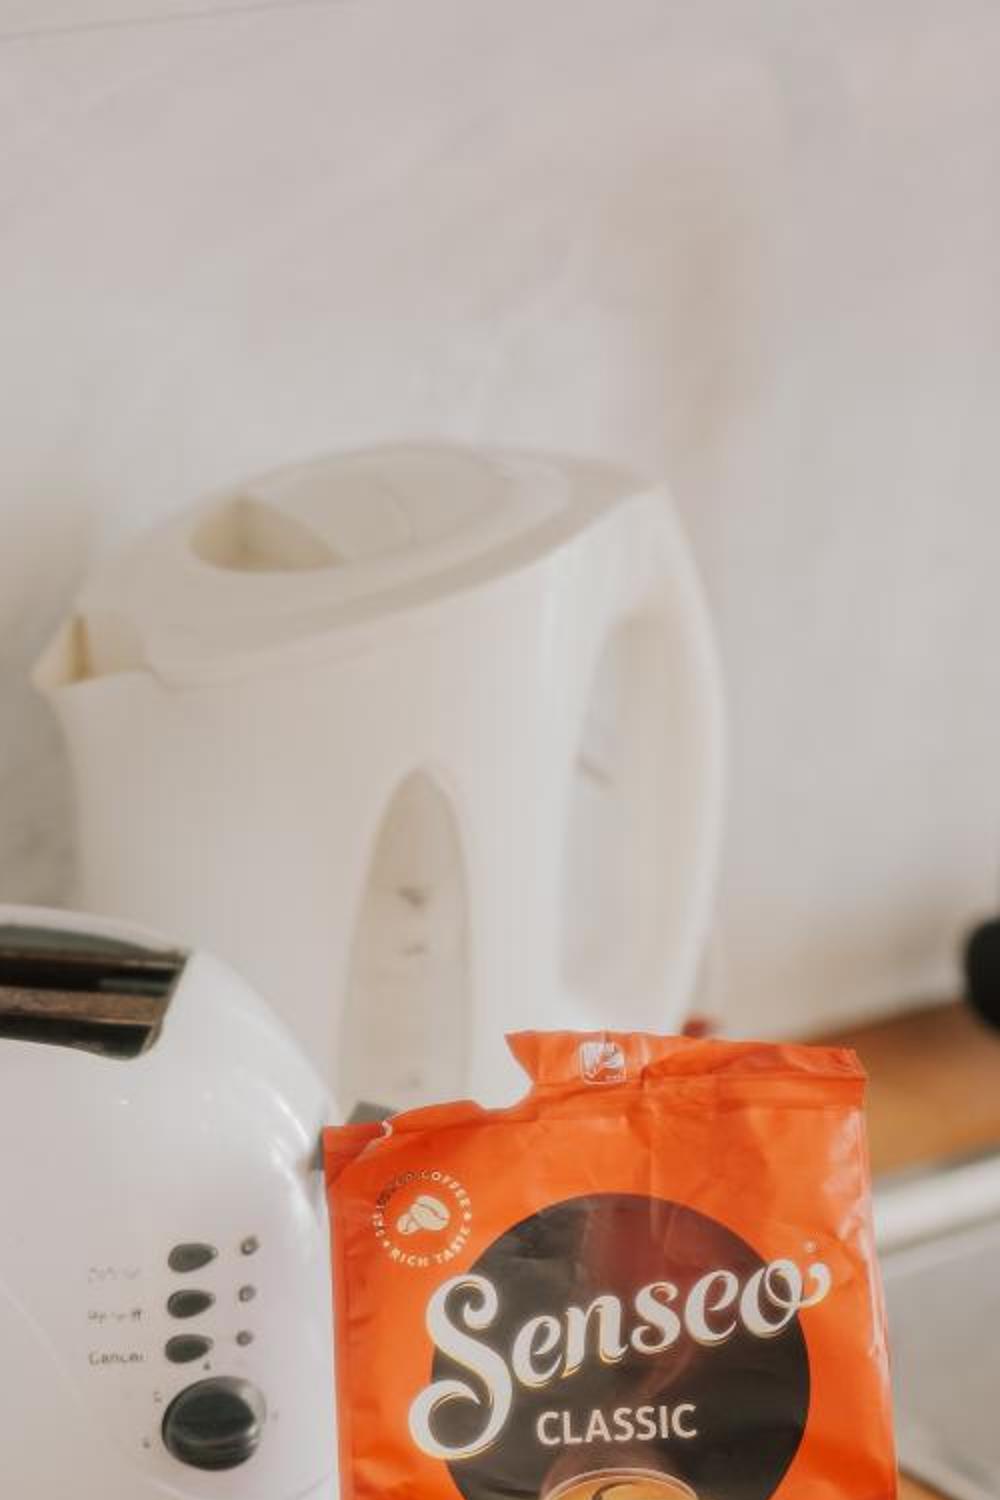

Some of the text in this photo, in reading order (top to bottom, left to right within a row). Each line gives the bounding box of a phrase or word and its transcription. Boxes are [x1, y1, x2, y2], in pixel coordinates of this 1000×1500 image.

[389, 1247, 431, 1268] RICH
[408, 1259, 832, 1460] Senseo
[536, 1403, 697, 1447] CLASSIC
